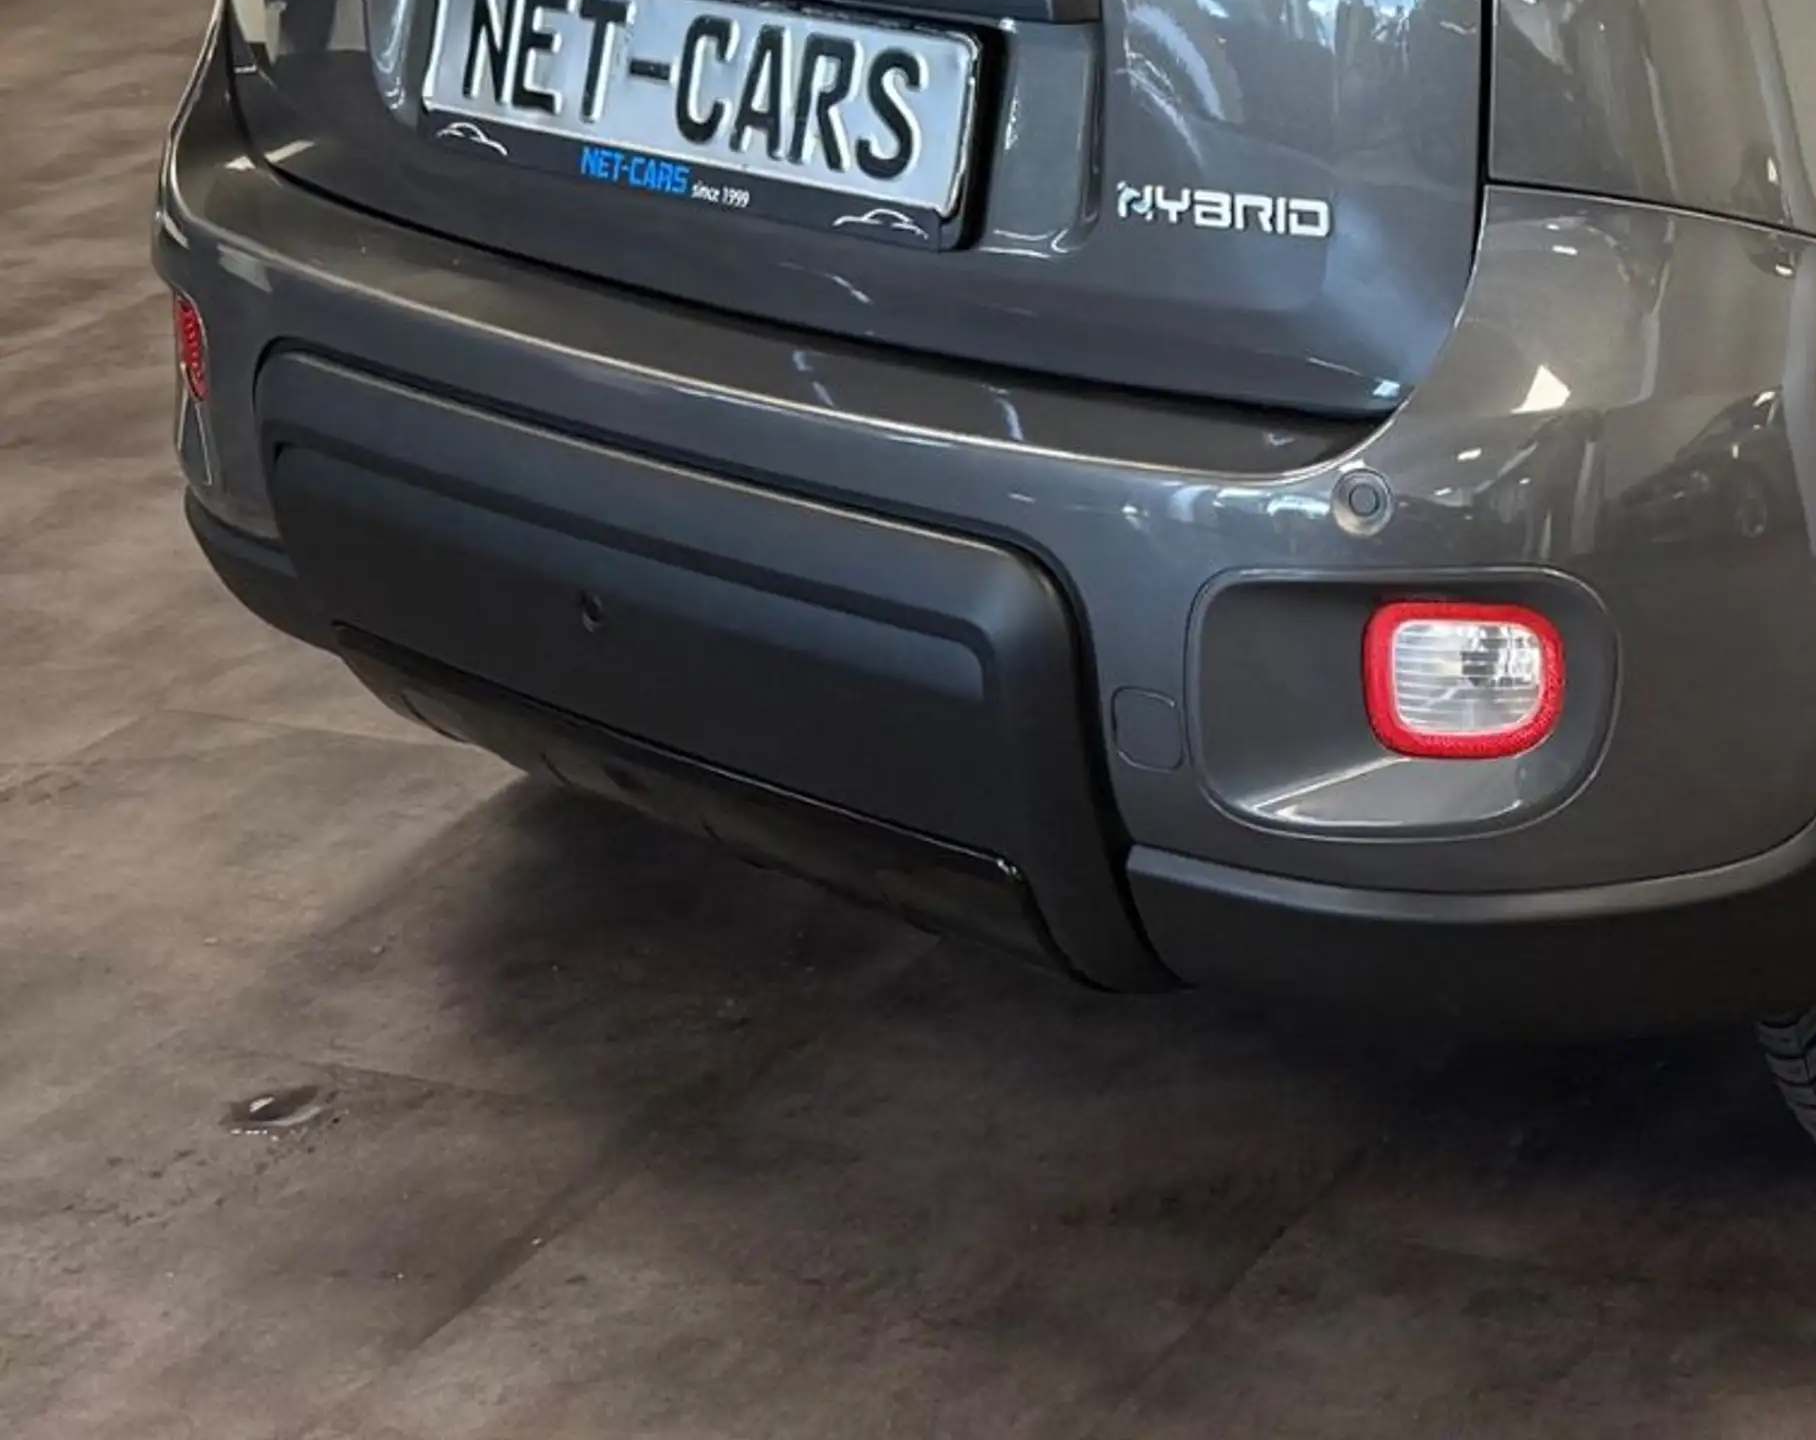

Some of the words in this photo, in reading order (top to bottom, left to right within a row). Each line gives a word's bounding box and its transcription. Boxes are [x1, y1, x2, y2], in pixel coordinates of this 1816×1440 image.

[580, 144, 692, 195] NET-CARS
[691, 180, 721, 203] since
[722, 184, 750, 208] 1999
[1116, 180, 1334, 238] HYBRID
